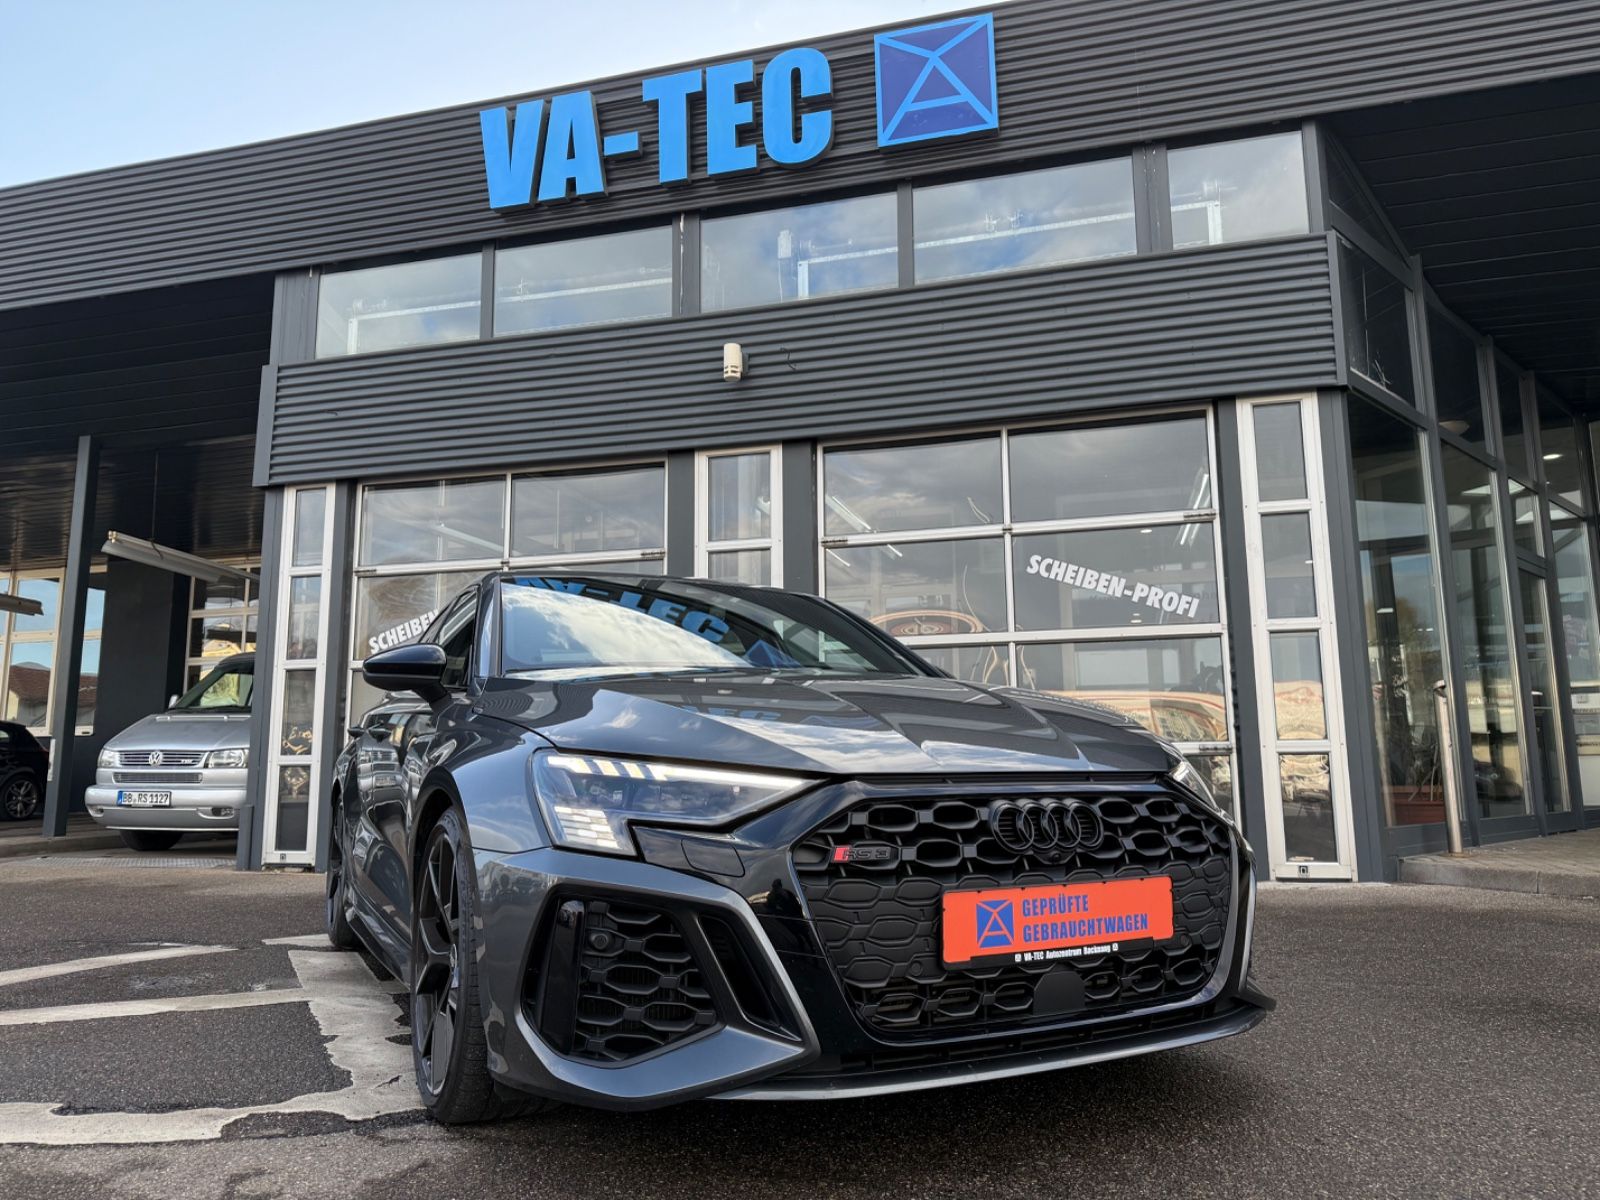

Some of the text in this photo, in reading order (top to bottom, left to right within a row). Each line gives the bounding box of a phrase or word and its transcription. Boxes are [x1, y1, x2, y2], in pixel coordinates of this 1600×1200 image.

[479, 47, 834, 211] VA-TEC
[1026, 554, 1200, 618] SCHEIBEN-PROFI
[149, 793, 169, 803] 1127
[1022, 894, 1089, 917] GEPRÜFTE
[1023, 913, 1148, 943] GEBRAUCHTWAGEN
[1023, 951, 1044, 962] VA-TEC
